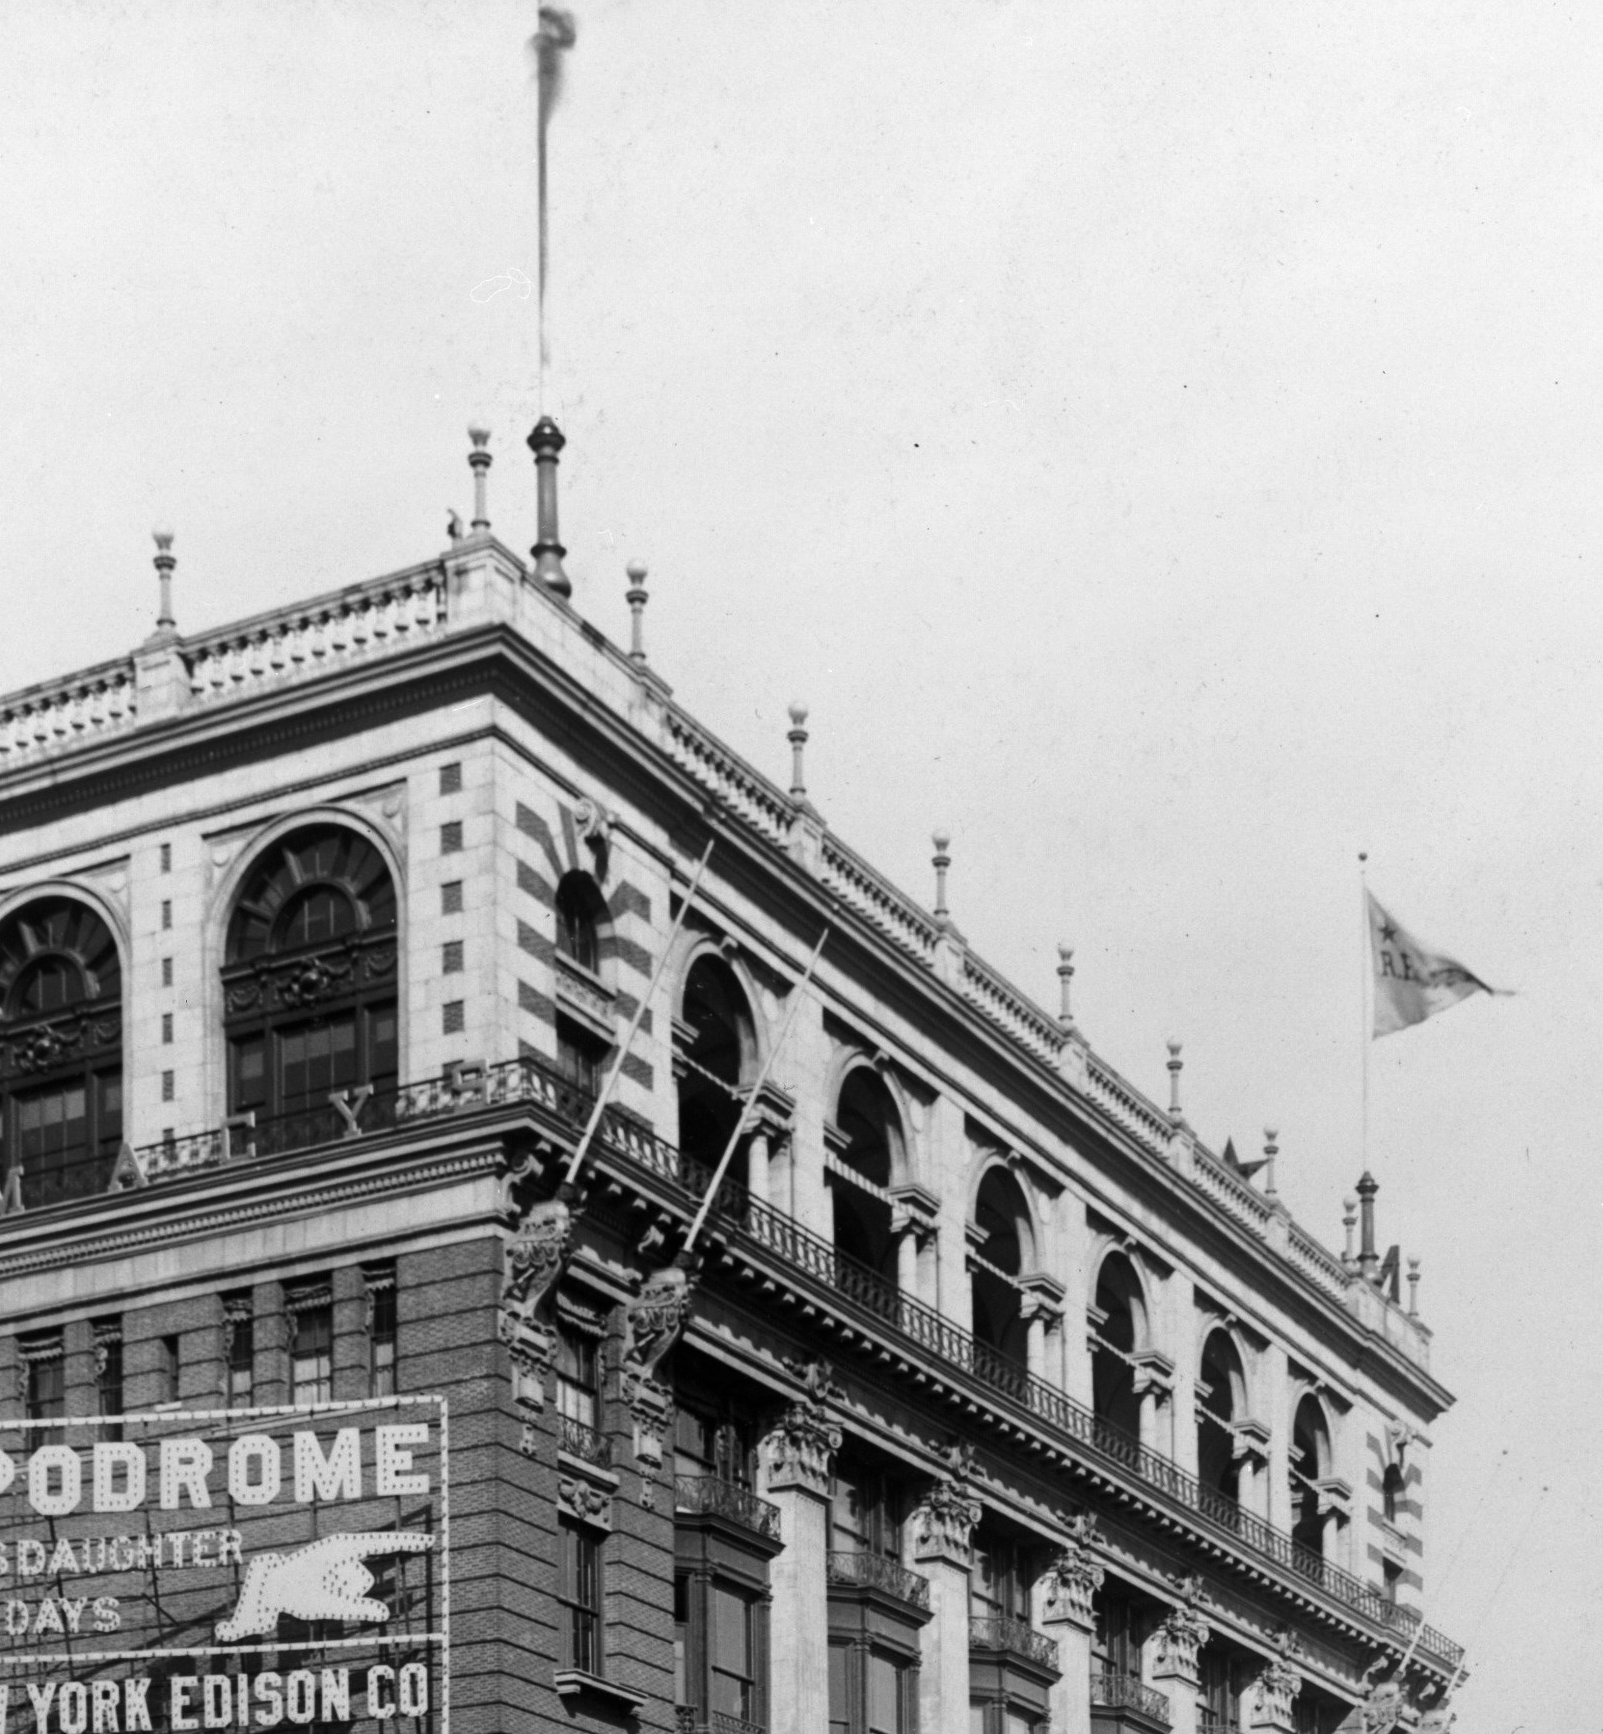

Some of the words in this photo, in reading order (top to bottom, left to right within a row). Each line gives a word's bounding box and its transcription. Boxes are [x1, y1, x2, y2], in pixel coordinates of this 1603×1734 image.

[18, 1529, 243, 1576] DAUGHTER
[7, 1596, 122, 1635] DAYS
[27, 1677, 153, 1734] YORK
[169, 1667, 350, 1732] EDISON
[367, 1662, 429, 1718] CO
